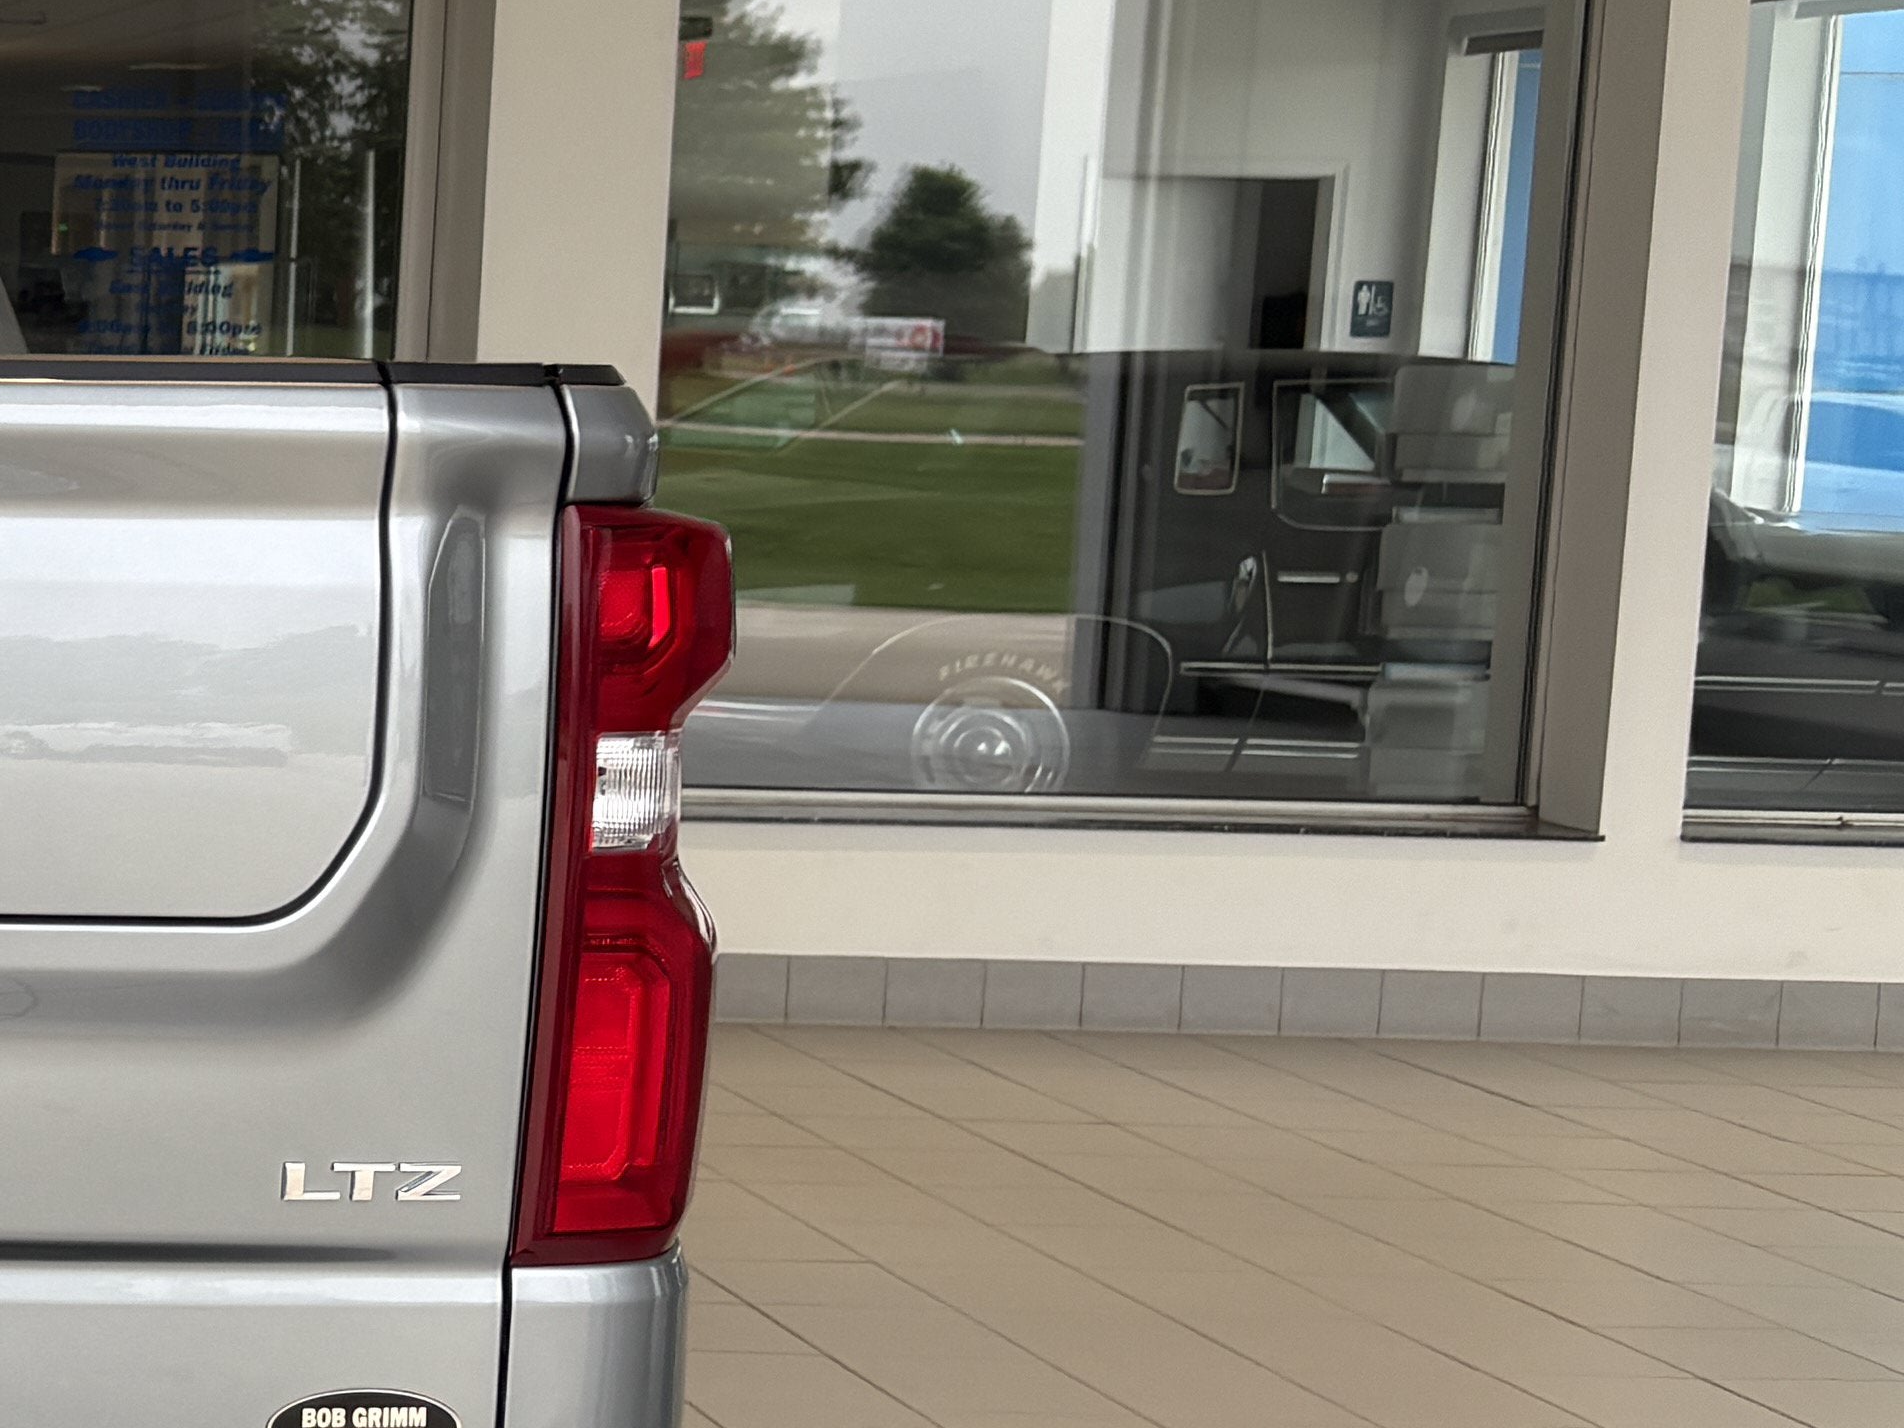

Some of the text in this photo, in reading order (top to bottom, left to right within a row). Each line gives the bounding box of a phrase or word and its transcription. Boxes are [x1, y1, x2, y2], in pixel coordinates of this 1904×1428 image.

[160, 175, 201, 191] thru
[281, 1161, 462, 1201] LTZ
[301, 1407, 427, 1428] BOB GRIMM
